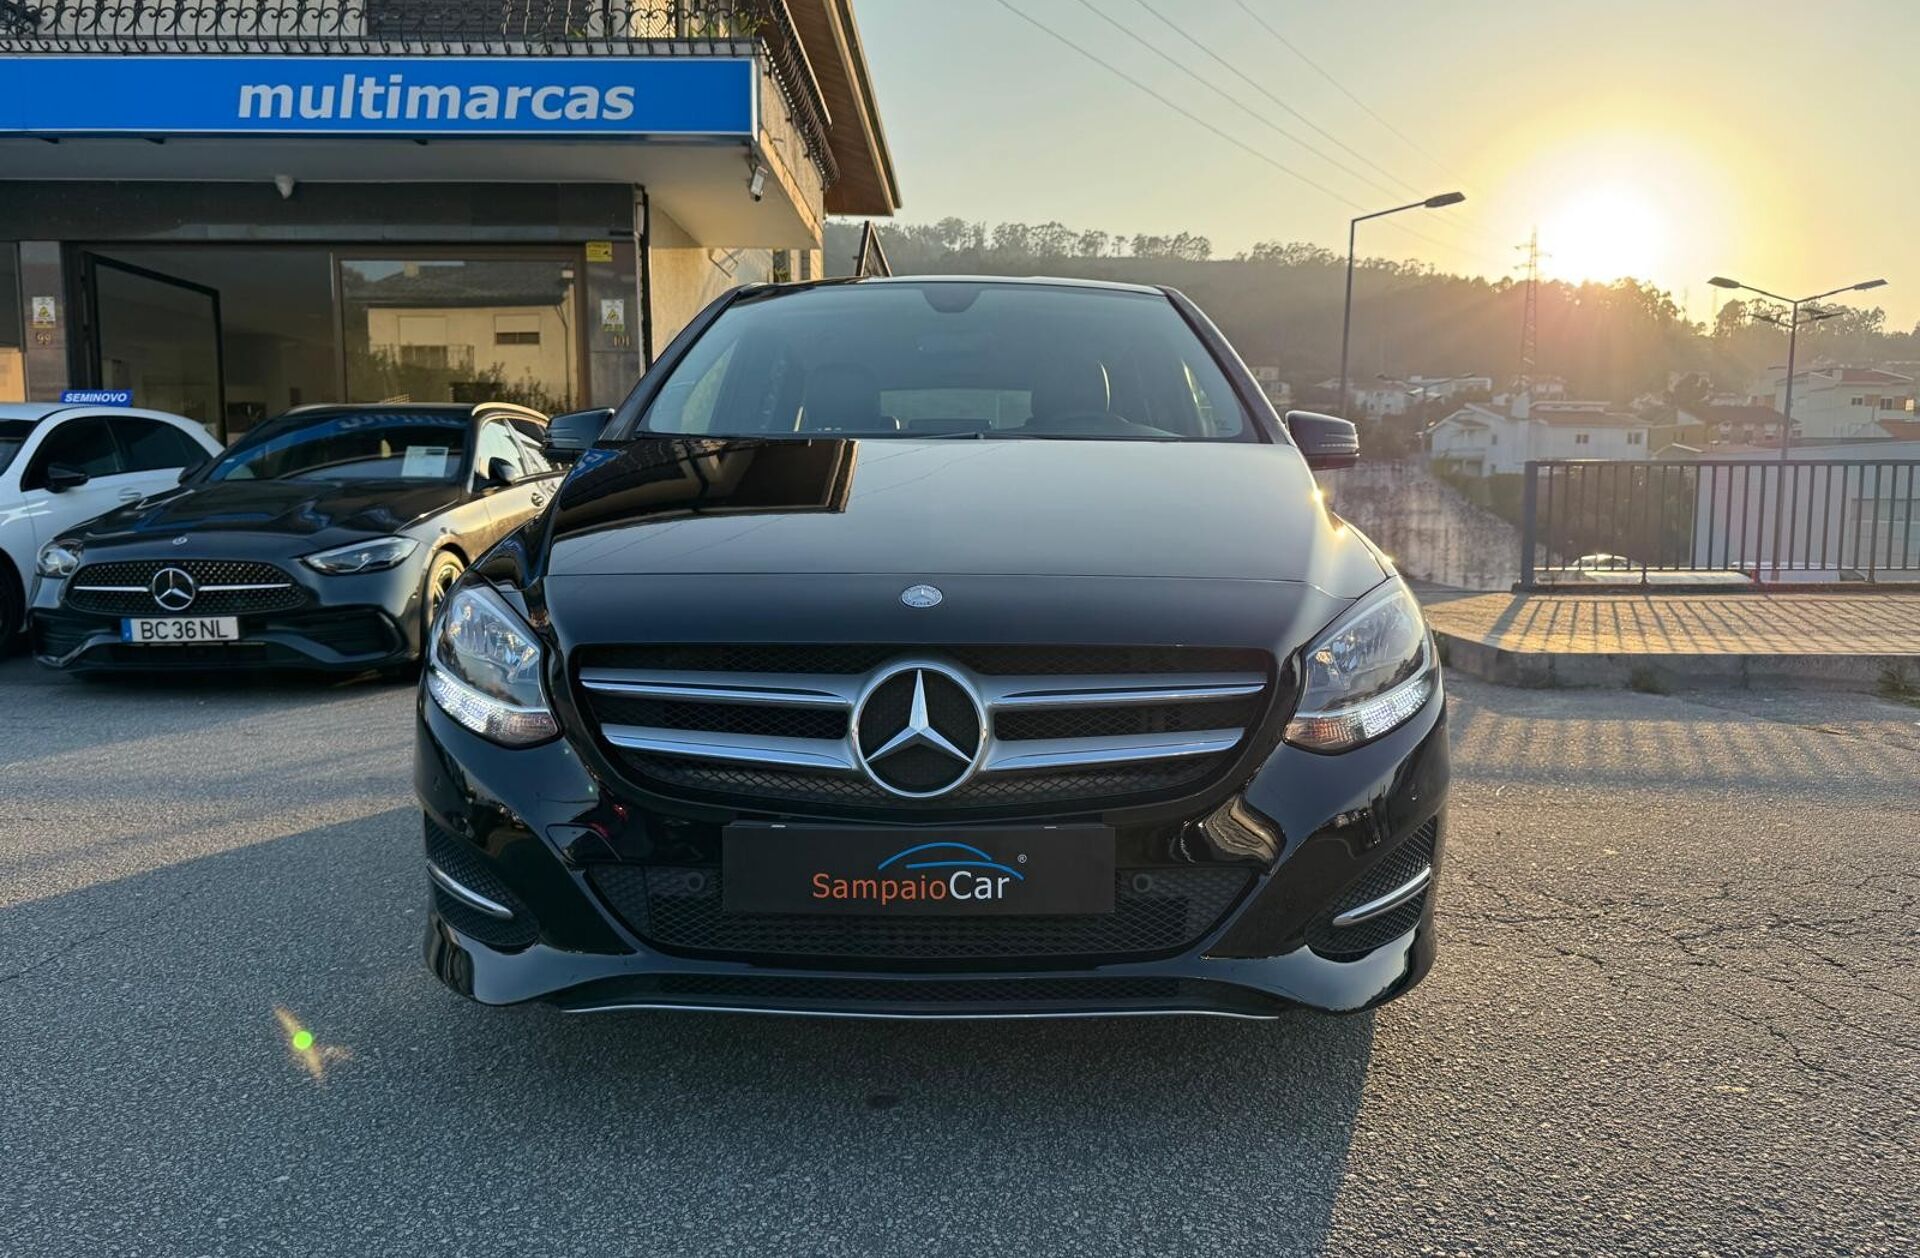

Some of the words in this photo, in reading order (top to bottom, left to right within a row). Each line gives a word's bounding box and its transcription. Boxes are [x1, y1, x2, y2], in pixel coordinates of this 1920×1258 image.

[238, 74, 635, 120] multimarcas
[64, 393, 128, 402] SEMINOVO
[141, 621, 168, 639] BC
[172, 621, 197, 639] 36
[200, 620, 229, 639] NL
[812, 871, 1010, 905] SampaioCar
